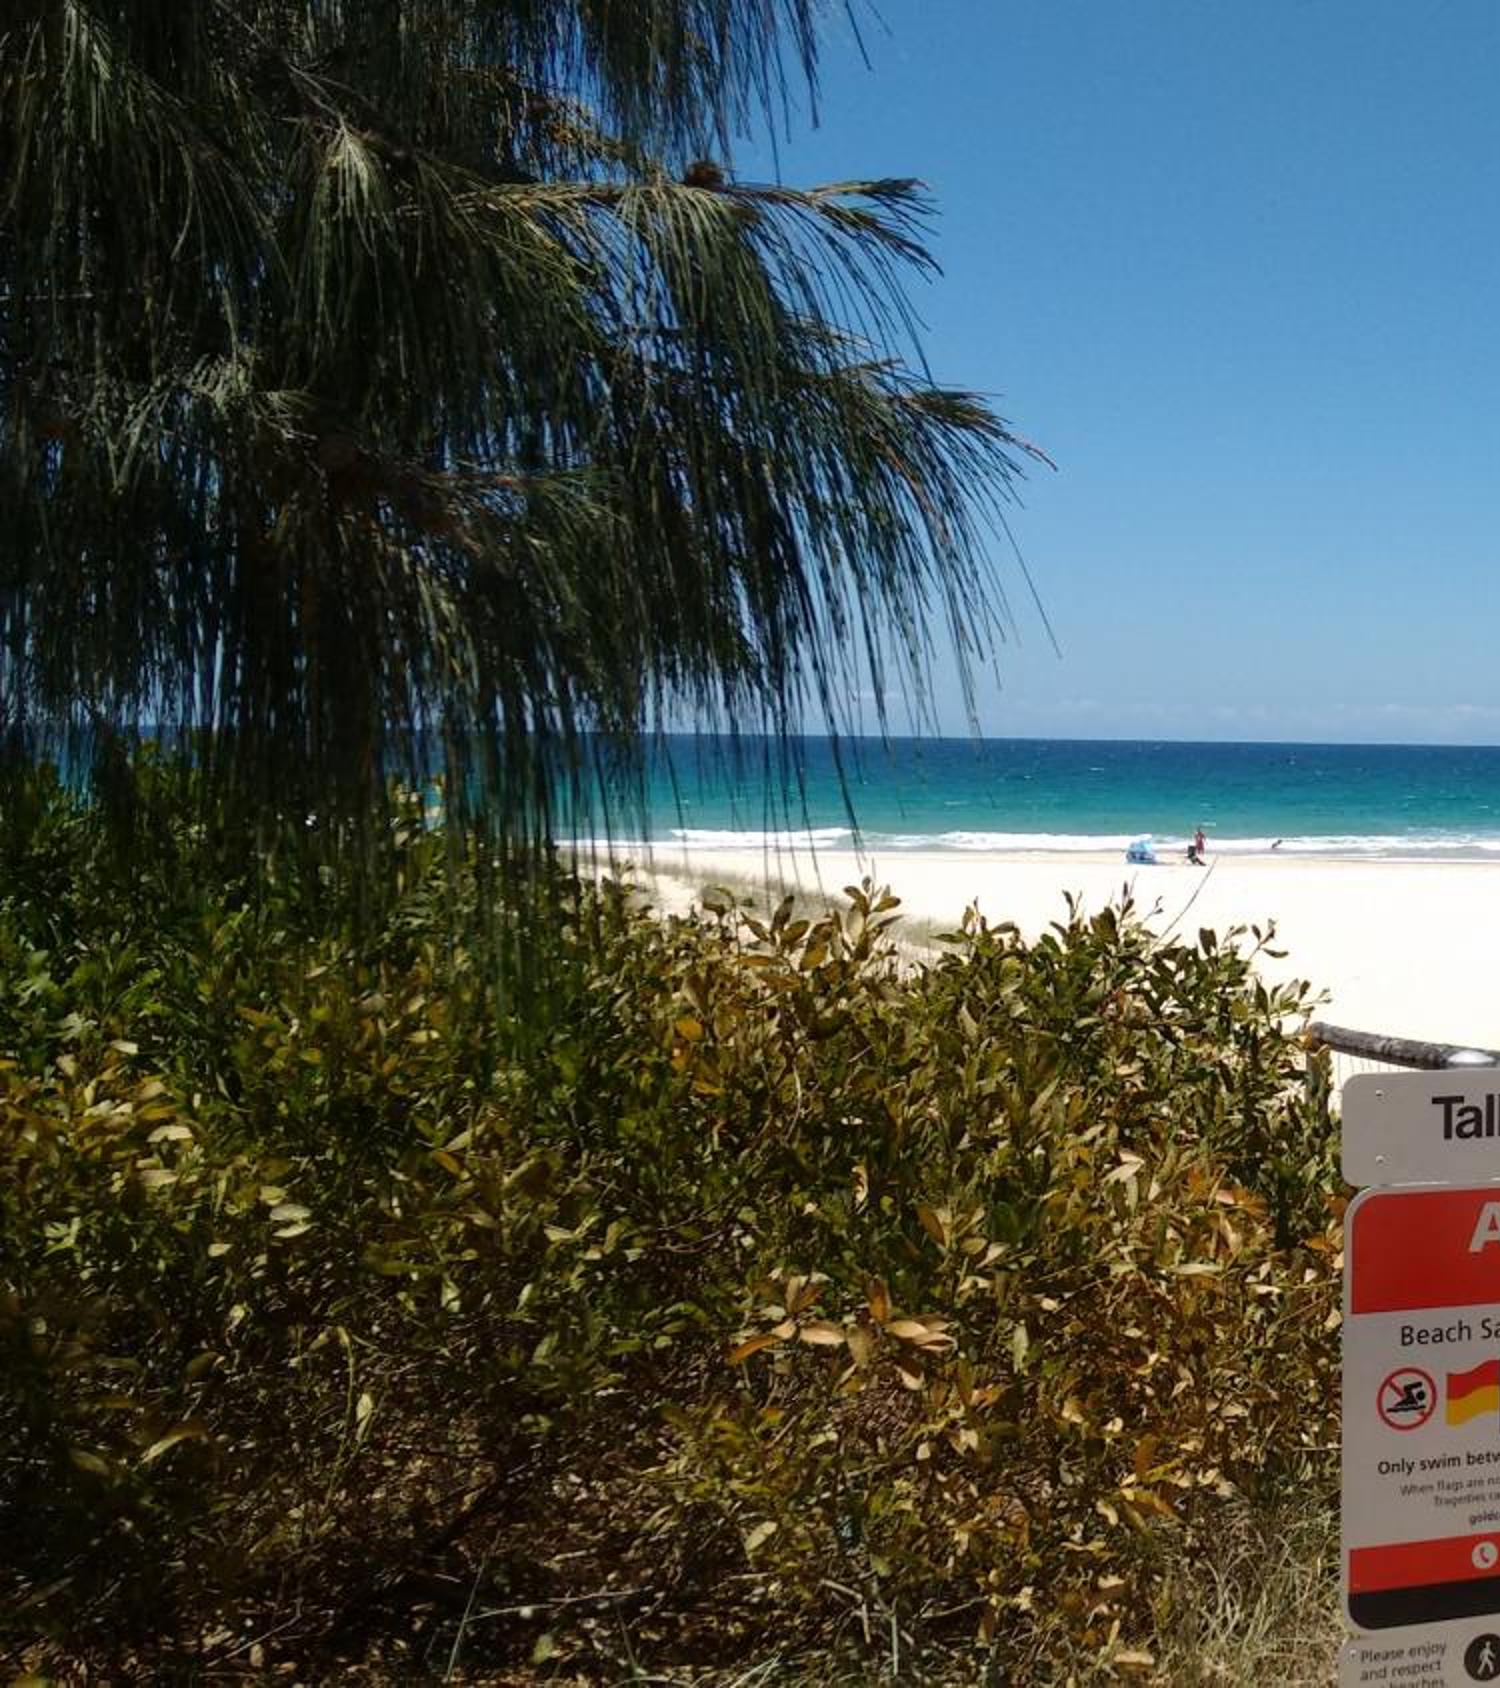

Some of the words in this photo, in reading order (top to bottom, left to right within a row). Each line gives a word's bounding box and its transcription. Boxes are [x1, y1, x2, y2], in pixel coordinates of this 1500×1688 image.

[1400, 1320, 1472, 1346] Beach
[1377, 1458, 1415, 1476] Only
[1419, 1455, 1461, 1471] swim
[1399, 1482, 1434, 1497] When
[1437, 1479, 1464, 1492] flags
[1466, 1476, 1484, 1488] are
[1361, 1649, 1405, 1662] Please
[1408, 1642, 1447, 1659] enjoy
[1360, 1665, 1387, 1681] and
[1391, 1660, 1441, 1677] respect
